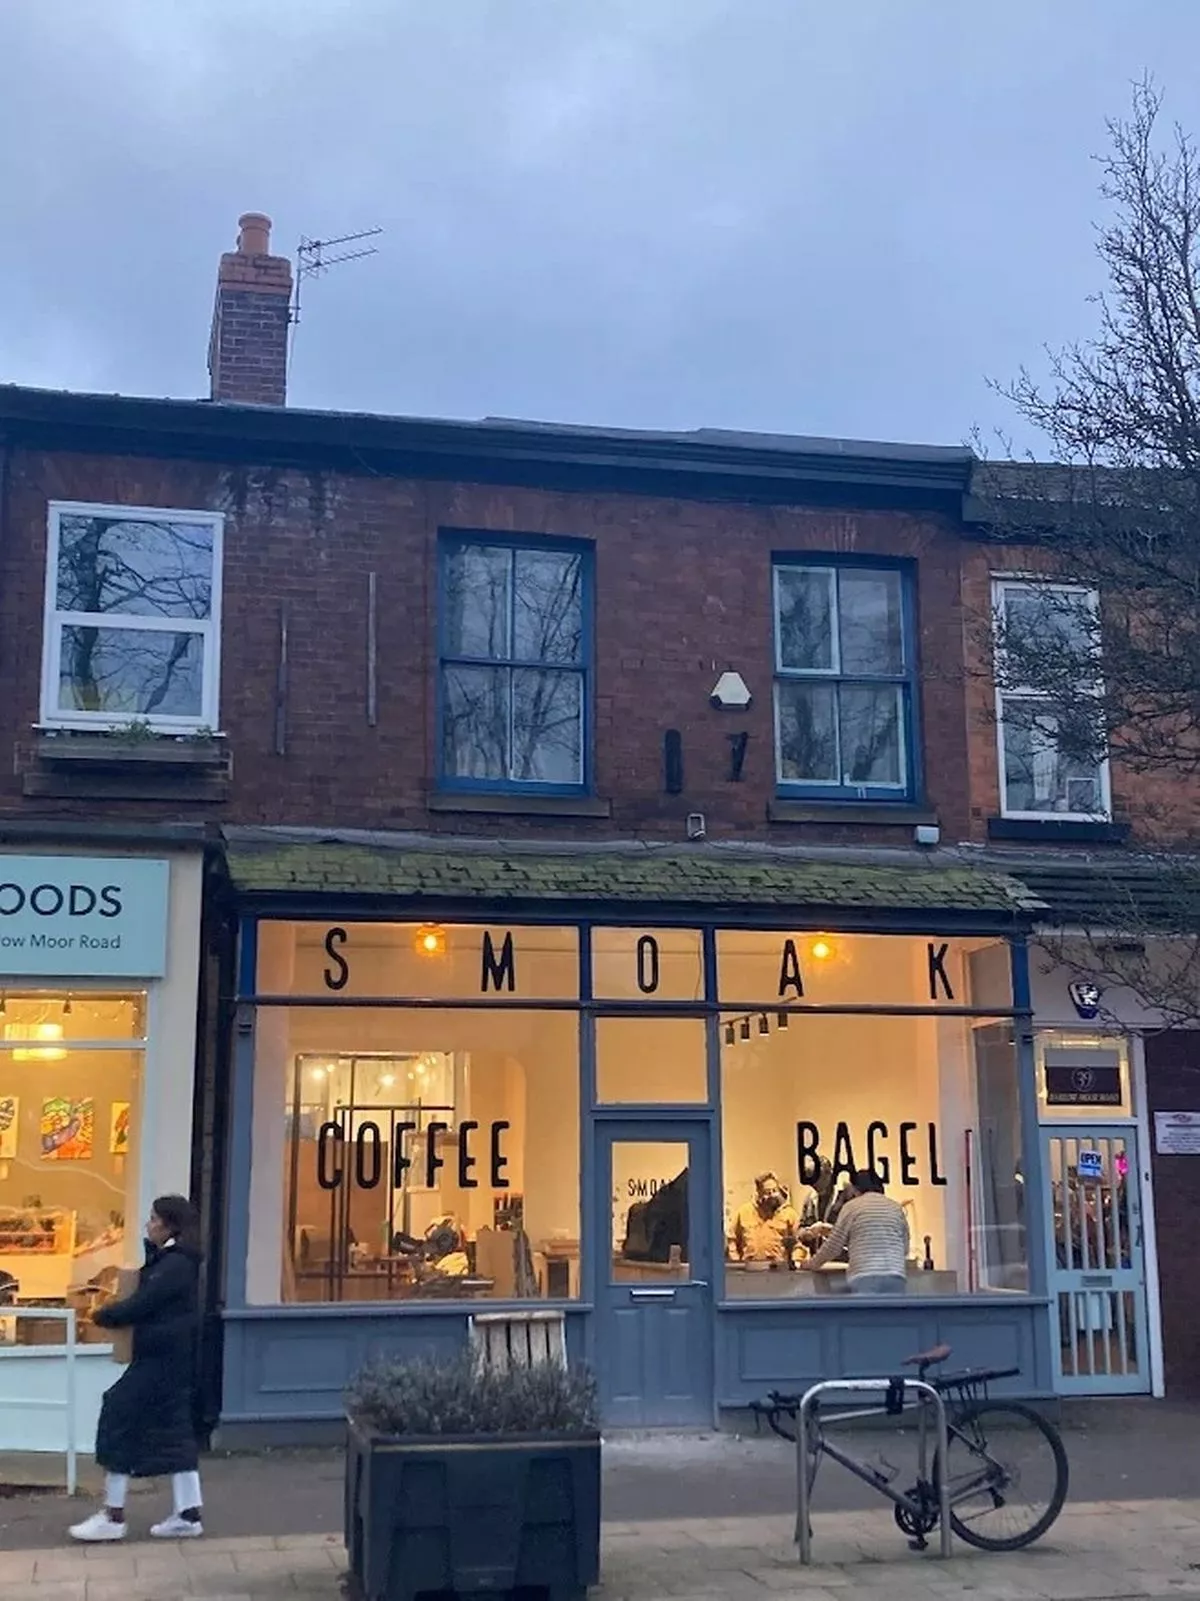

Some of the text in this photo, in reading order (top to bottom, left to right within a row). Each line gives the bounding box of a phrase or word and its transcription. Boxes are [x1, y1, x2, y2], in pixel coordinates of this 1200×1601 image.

[30, 934, 75, 949] Moor
[80, 934, 121, 949] Road
[318, 1121, 510, 1189] COFFEE
[797, 1121, 948, 1186] BAGEL
[1081, 1152, 1102, 1165] OPEN
[628, 1178, 672, 1197] SMO
